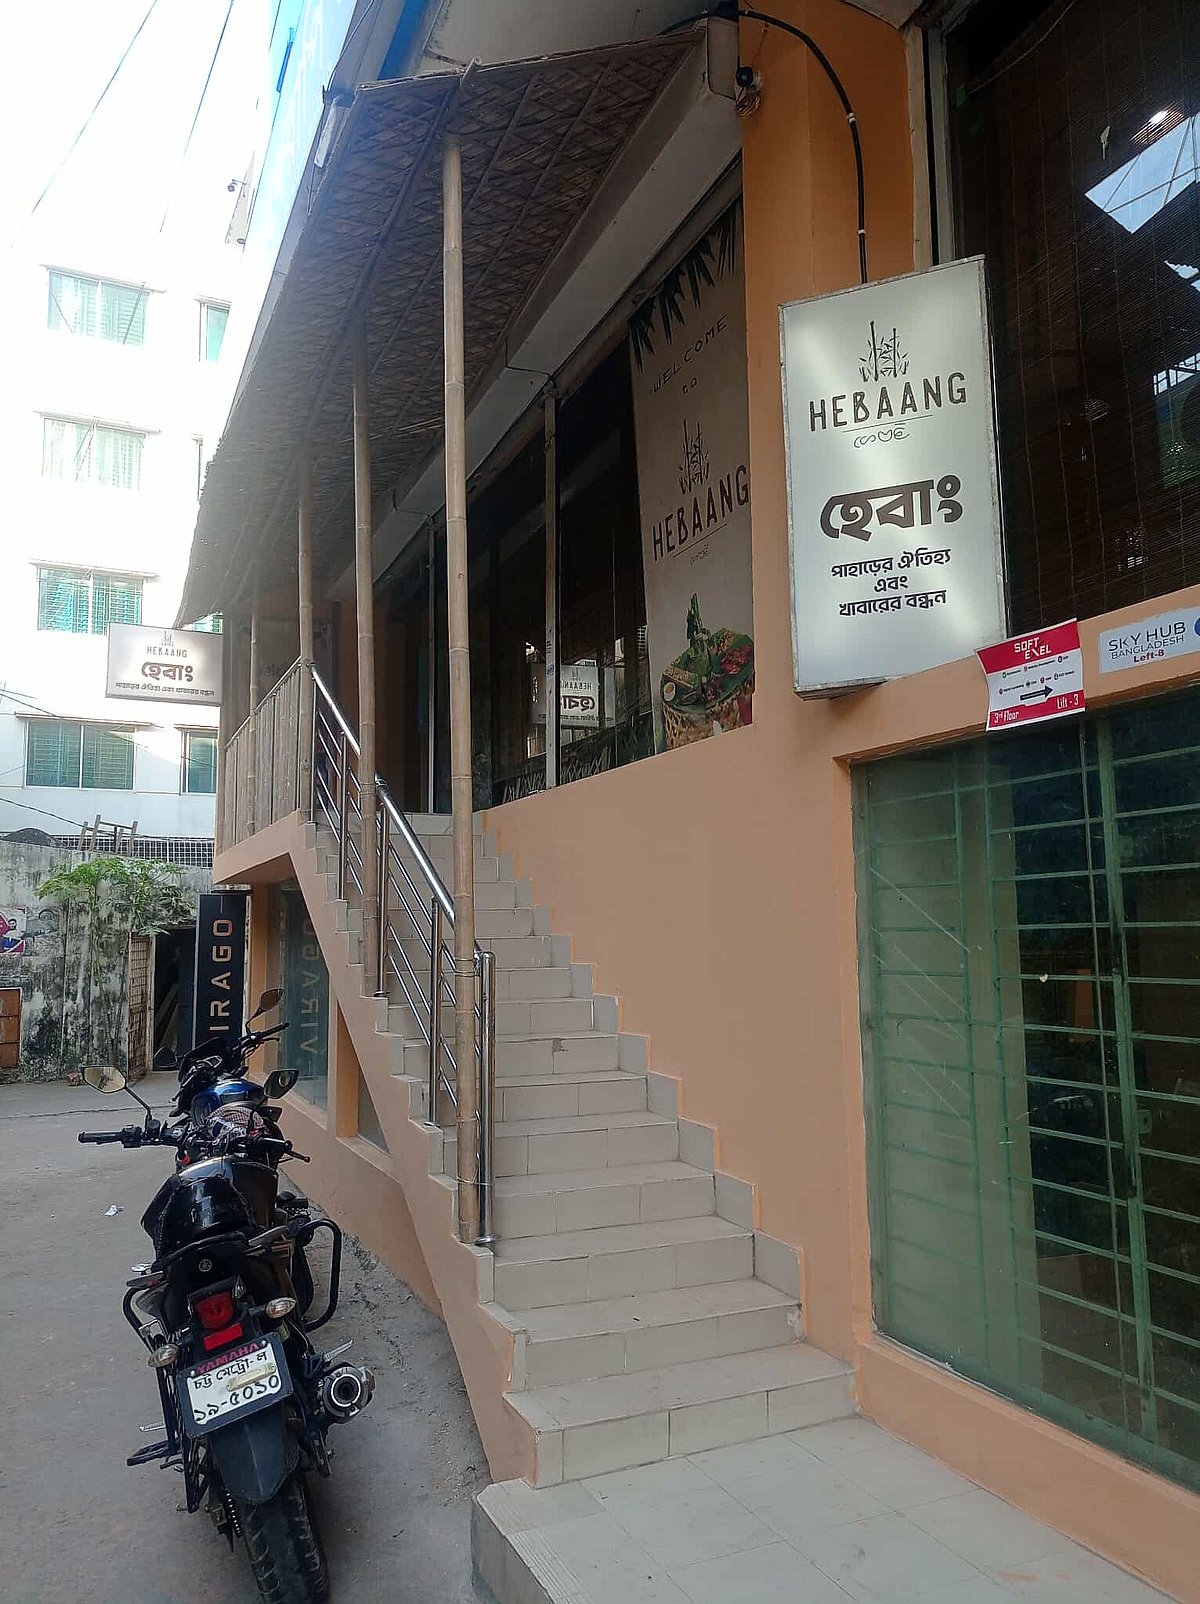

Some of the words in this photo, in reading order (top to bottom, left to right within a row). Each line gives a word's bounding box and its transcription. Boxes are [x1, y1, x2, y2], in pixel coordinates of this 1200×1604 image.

[653, 314, 727, 392] WELCOME
[682, 378, 698, 394] to
[810, 372, 967, 431] HEBAANG
[653, 465, 749, 561] HEBAANG
[820, 474, 963, 542] হেবাং
[831, 557, 893, 578] পাহাড়ের
[898, 548, 951, 569] ঐতিহ্য
[874, 576, 909, 592] এবং
[839, 596, 902, 616] খাবারের
[905, 590, 947, 609] বন্ধন
[1014, 637, 1040, 653] SOFT
[1109, 633, 1141, 651] SKY
[1147, 622, 1186, 642] HUB
[1112, 635, 1184, 659] BANGLADESH
[141, 662, 194, 682] হেবাং
[1004, 710, 1019, 722] Floor
[1057, 696, 1068, 709] Lift
[1074, 694, 1079, 706] 3
[210, 919, 233, 1031] IRAGO
[197, 1343, 260, 1374] YAMAHA
[194, 1375, 279, 1421] ১৯-৫০১০
